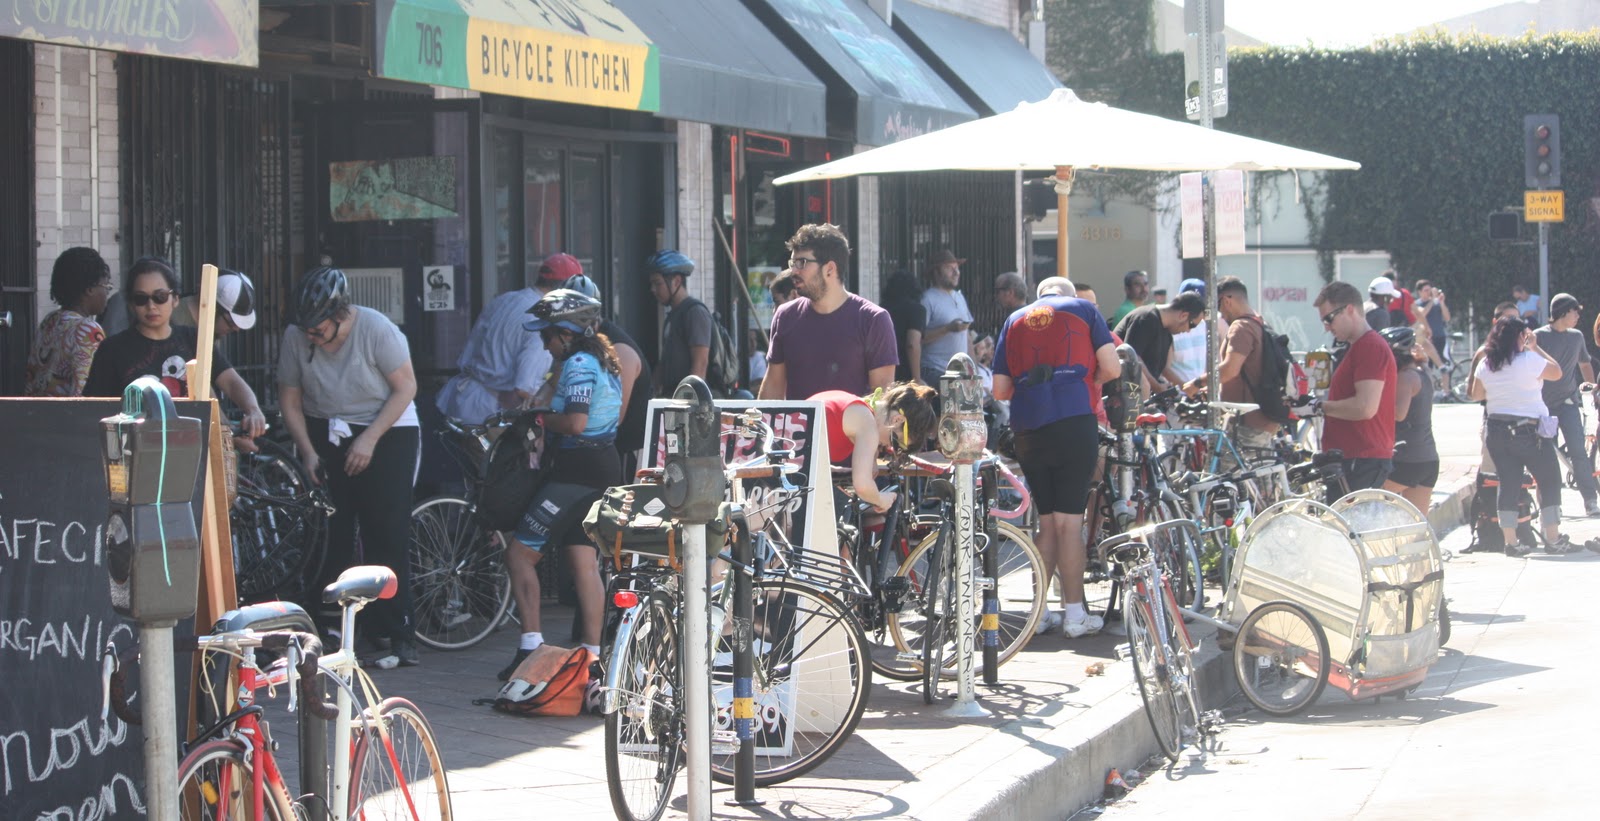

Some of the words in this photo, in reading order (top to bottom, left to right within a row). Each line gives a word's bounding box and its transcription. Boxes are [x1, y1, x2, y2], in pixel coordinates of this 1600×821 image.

[415, 22, 443, 67] 706
[481, 34, 554, 84] BICYCLE
[564, 49, 630, 93] KITCHEN
[1530, 195, 1559, 204] 3-WAY
[1529, 207, 1560, 216] SIGNAL
[1263, 287, 1307, 302] OPEN
